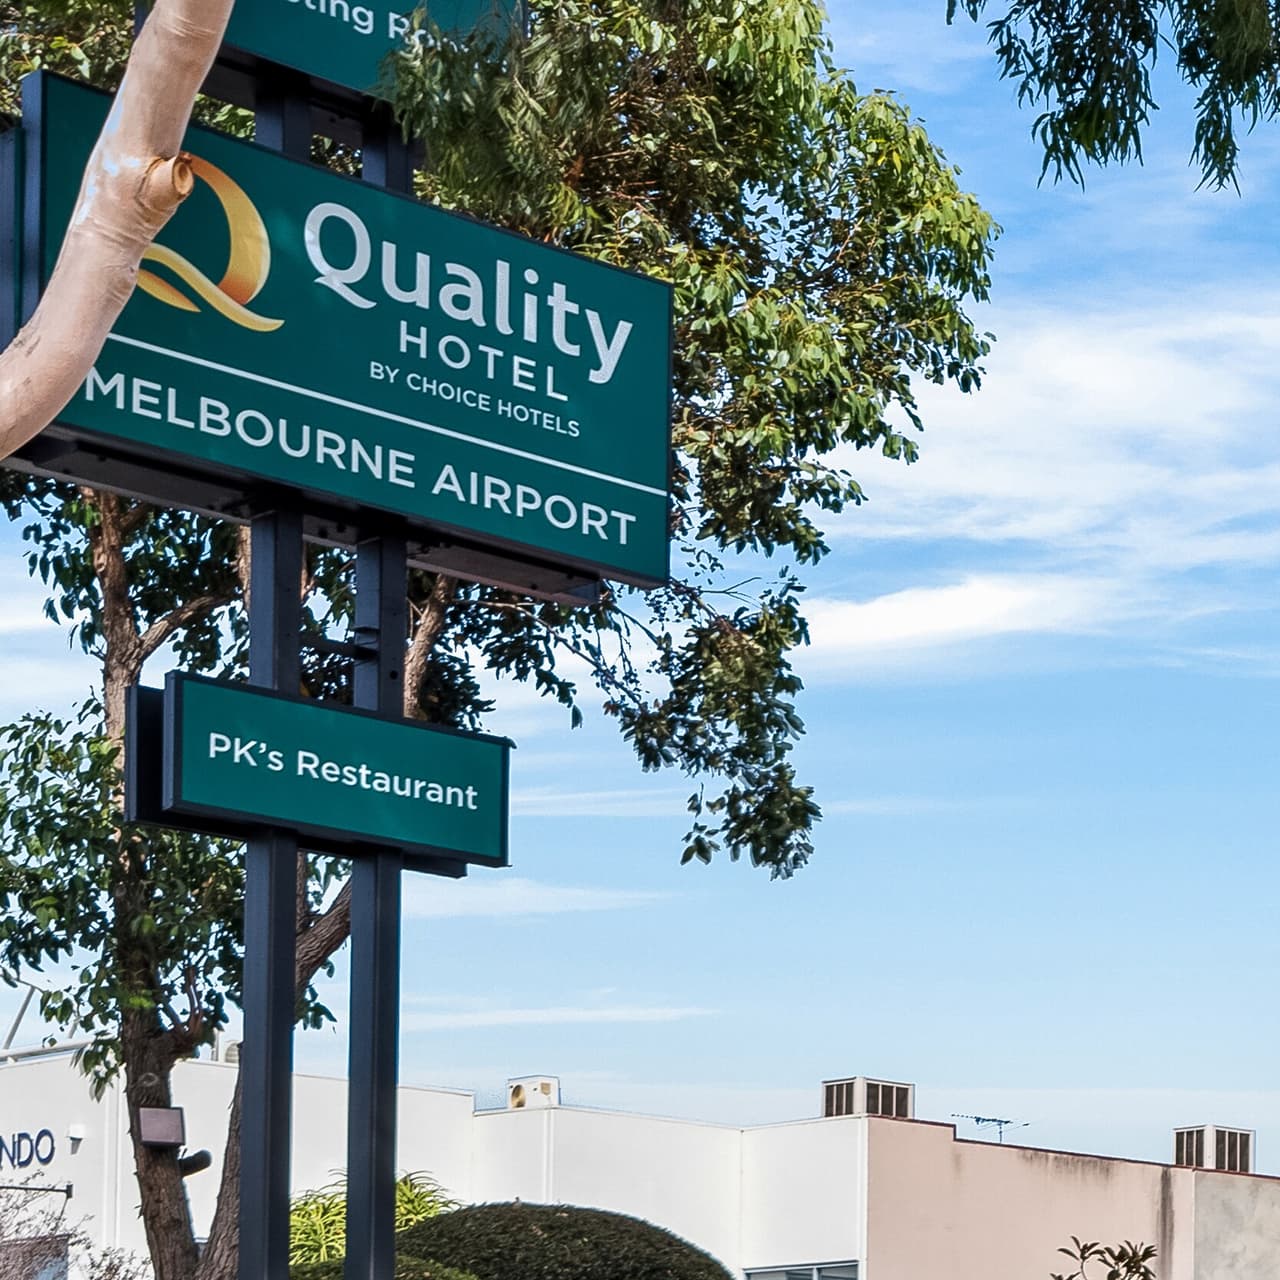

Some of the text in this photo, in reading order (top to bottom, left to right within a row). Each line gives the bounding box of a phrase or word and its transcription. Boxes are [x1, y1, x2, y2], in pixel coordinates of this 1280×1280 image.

[303, 202, 634, 385] Quality
[369, 360, 581, 438] BY CHOICE HOTELS
[400, 320, 570, 403] HOTEL
[85, 366, 637, 546] MELBOURNE AIRPORT
[296, 749, 479, 811] Restaurant
